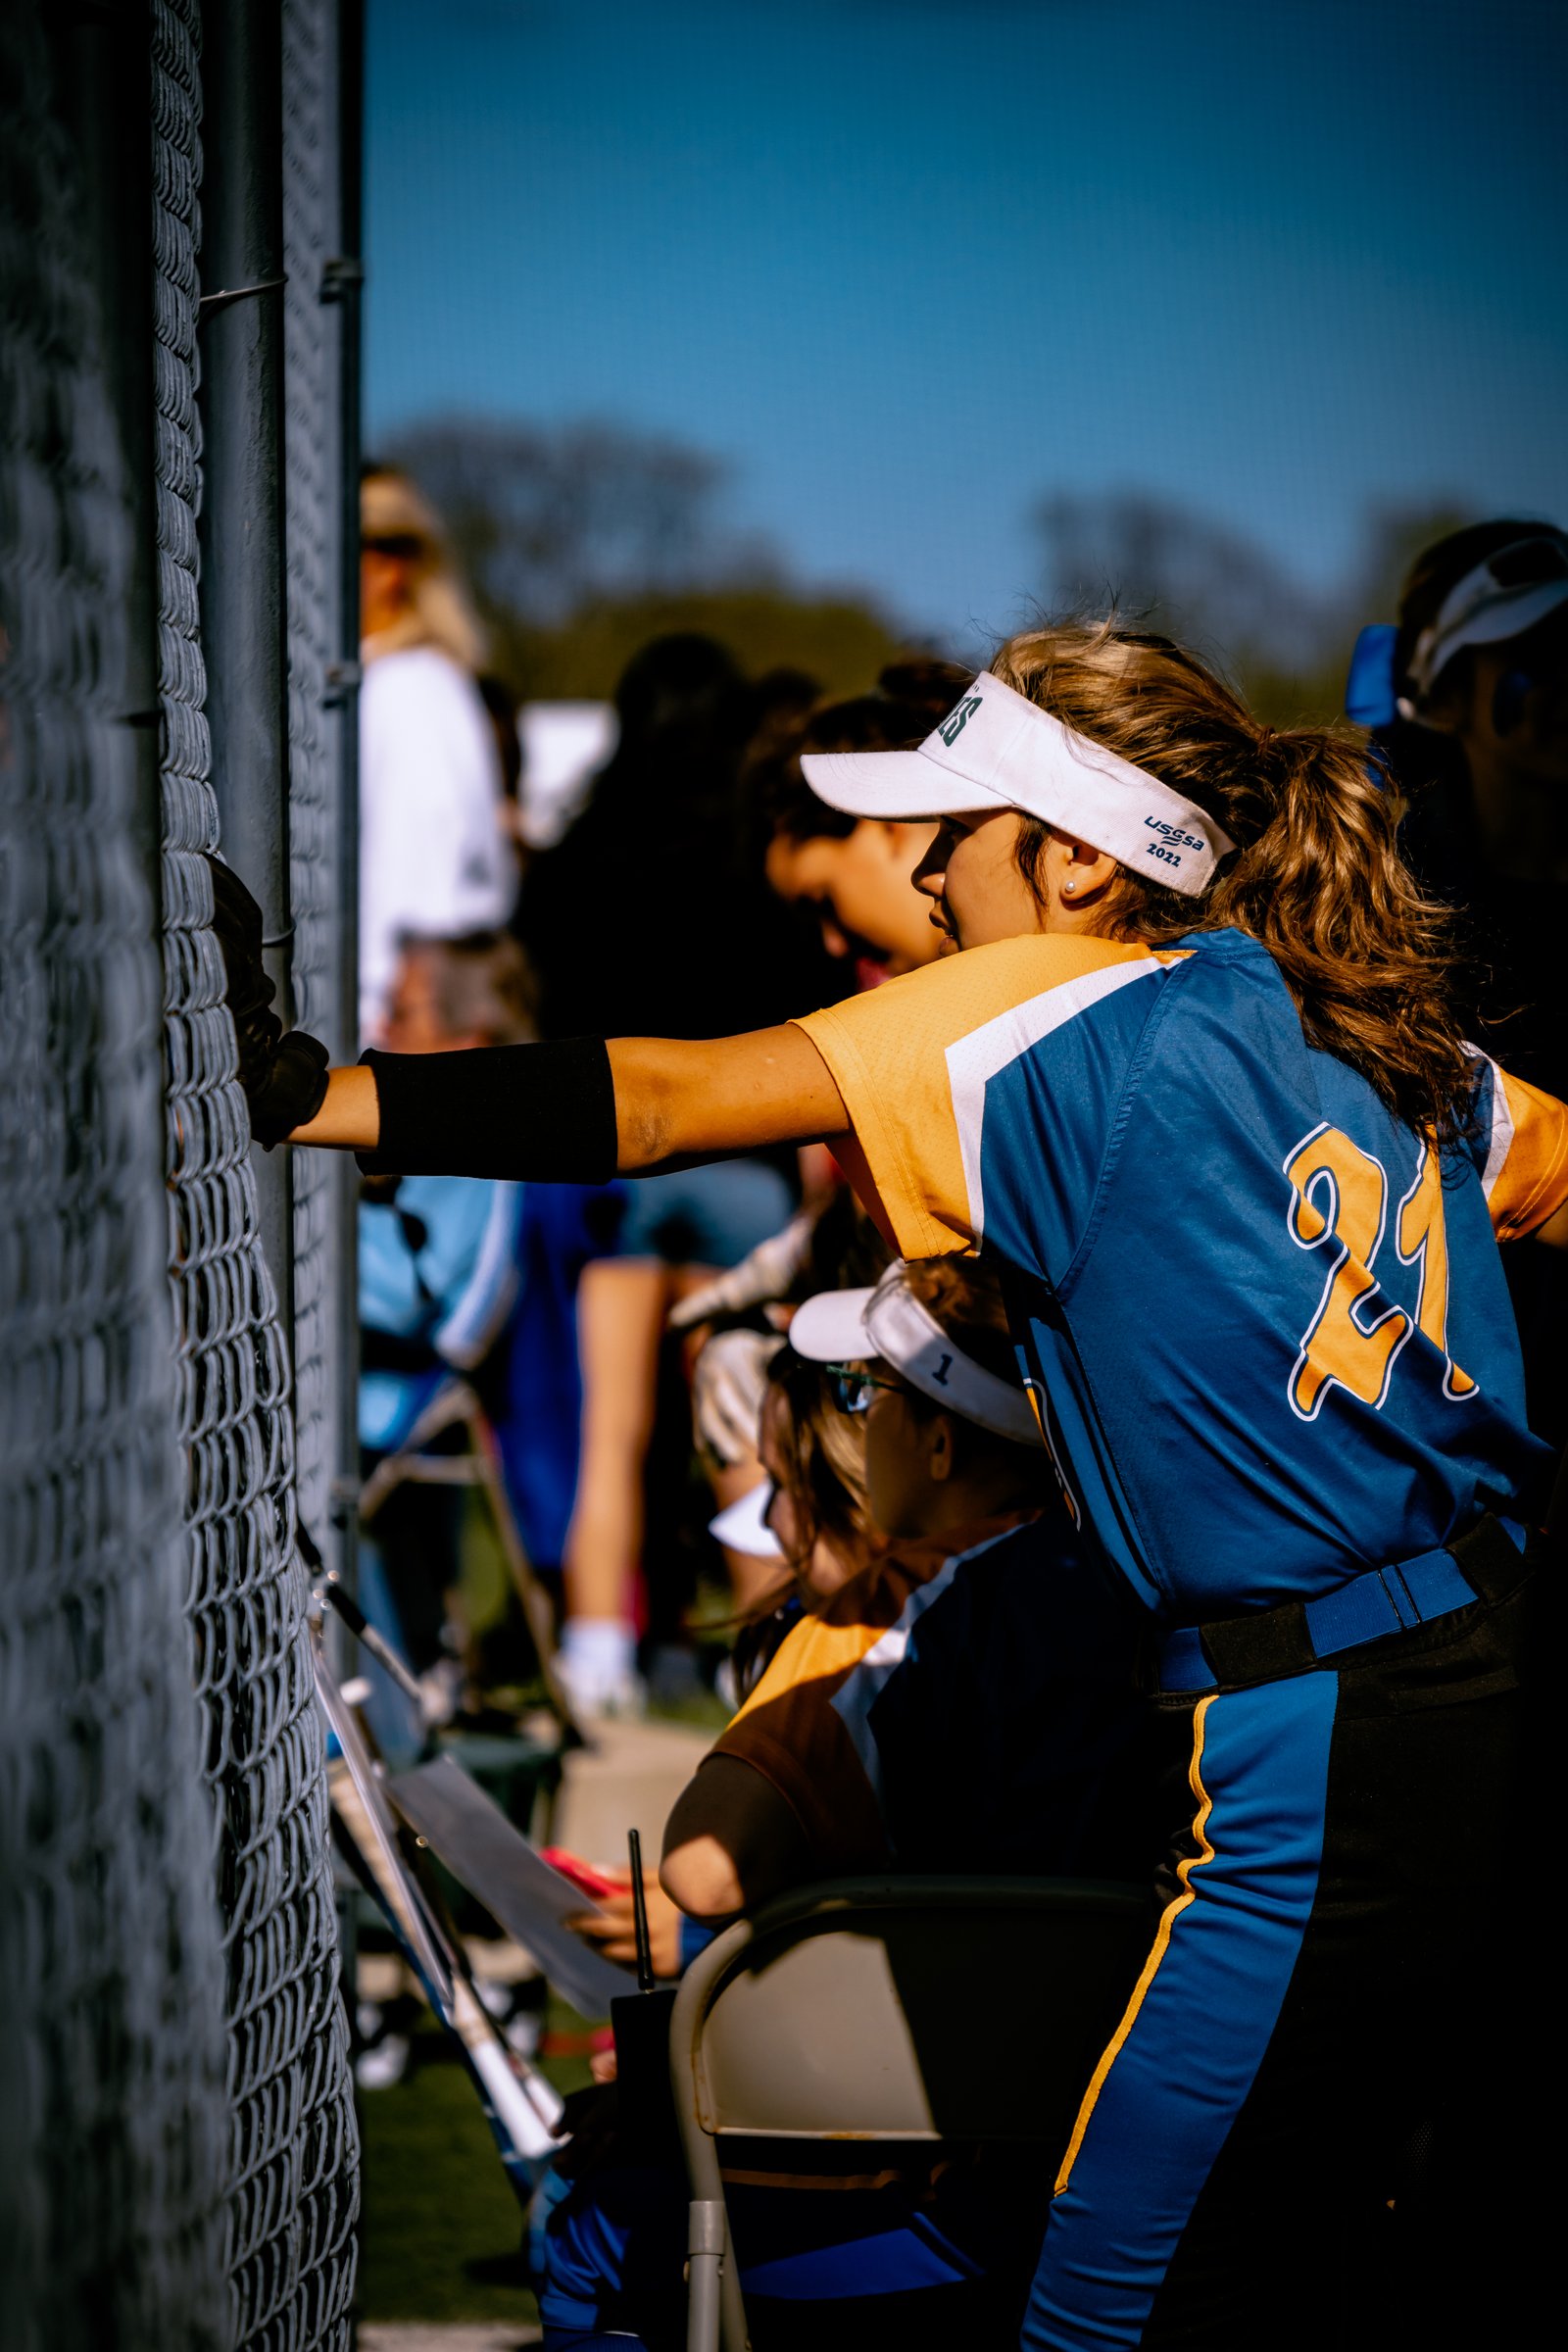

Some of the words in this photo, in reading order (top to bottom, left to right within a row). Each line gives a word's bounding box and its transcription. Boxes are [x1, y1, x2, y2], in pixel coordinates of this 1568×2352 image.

[936, 696, 984, 748] ES
[1146, 843, 1182, 868] 2022
[1282, 1120, 1481, 1422] 21
[932, 1353, 954, 1387] 1
